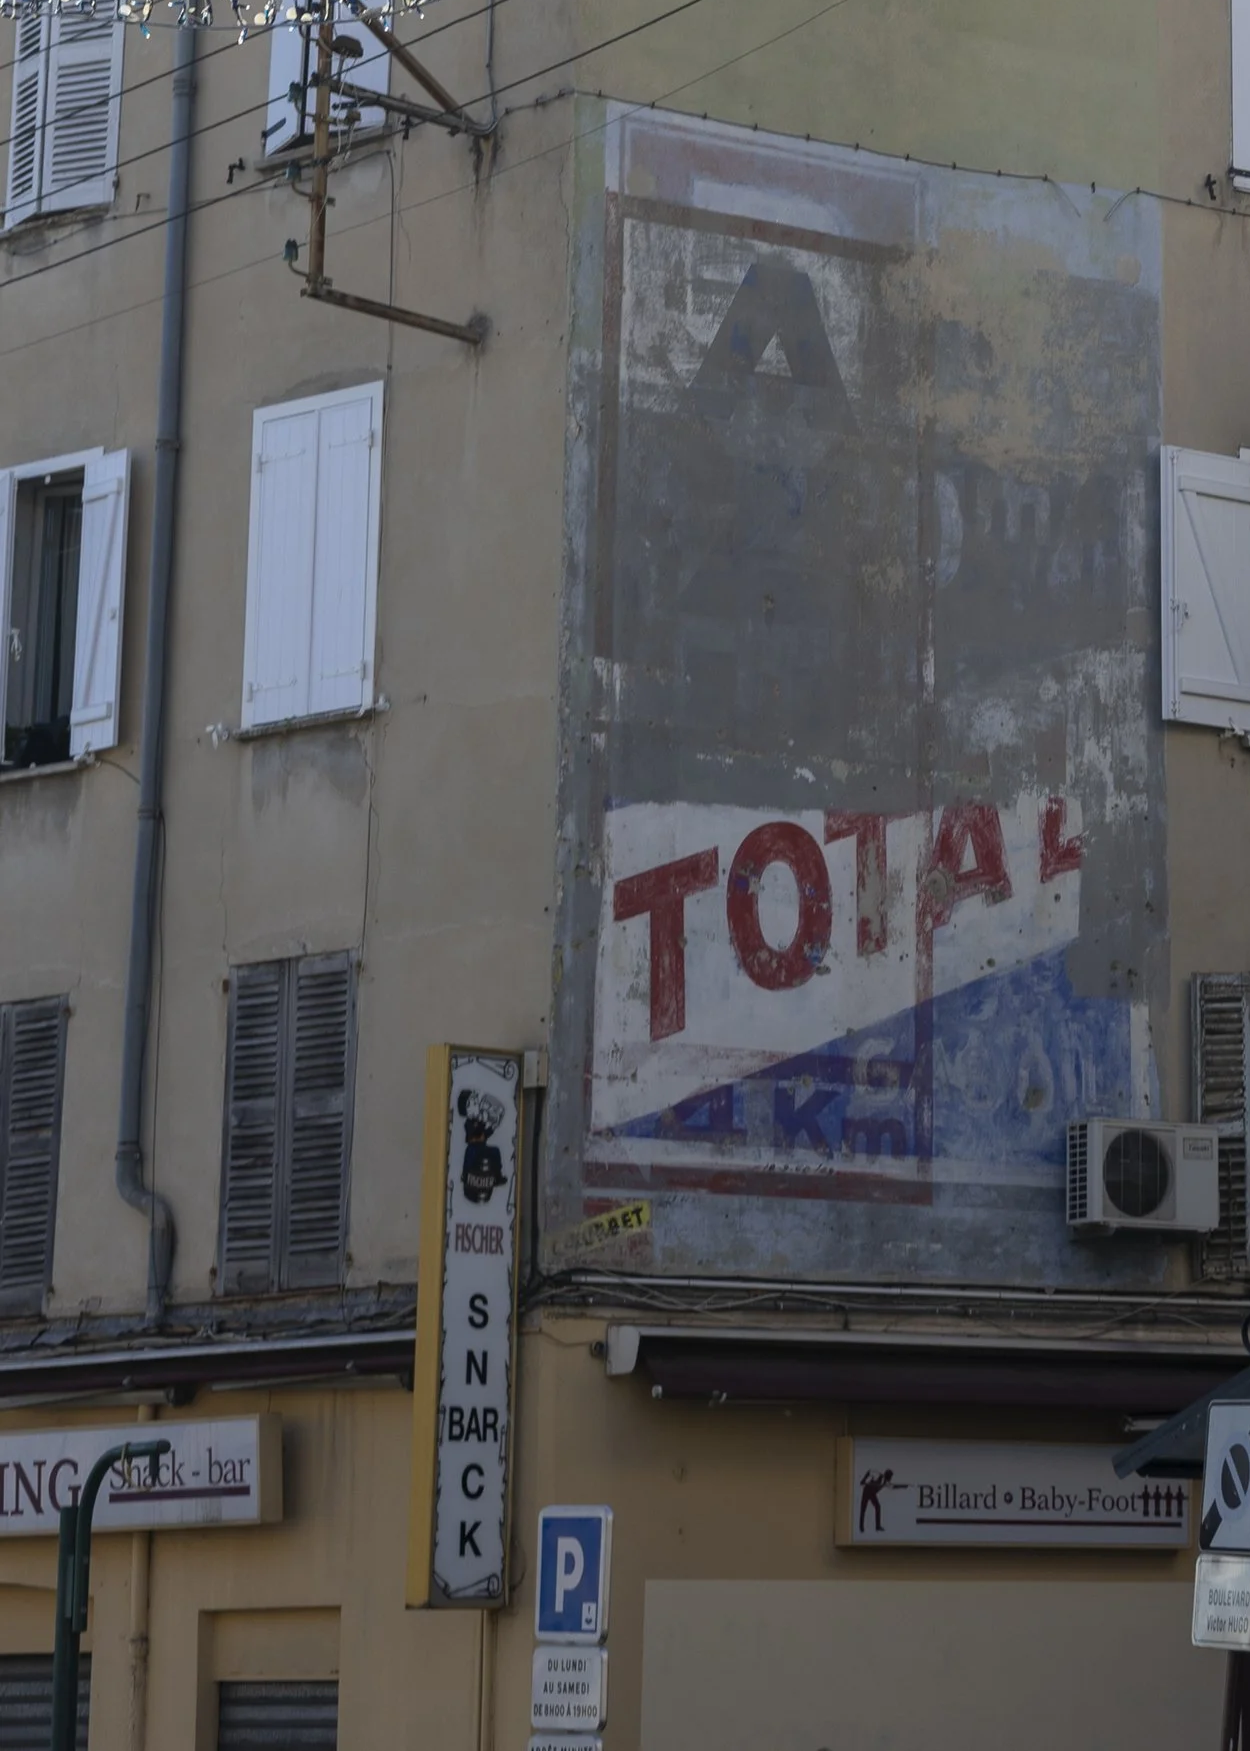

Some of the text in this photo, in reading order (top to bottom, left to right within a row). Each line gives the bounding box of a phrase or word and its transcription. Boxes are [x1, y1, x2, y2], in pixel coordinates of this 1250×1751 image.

[613, 795, 1086, 1043] TOTAL
[467, 1172, 495, 1188] FISCHER
[454, 1223, 504, 1255] FISCHER
[448, 1406, 499, 1442] BAR
[207, 1447, 250, 1484] bar
[917, 1484, 1139, 1518] Billard Baby-Foot
[555, 1537, 585, 1613] P
[1208, 1588, 1250, 1607] BOULEVARD
[1206, 1616, 1249, 1634] Victor HUGO
[547, 1658, 587, 1673] DU LUNDI
[543, 1681, 590, 1695] AU SAMEDI
[533, 1703, 543, 1717] DE
[544, 1704, 565, 1717] 8H00
[573, 1705, 598, 1718] 19H00
